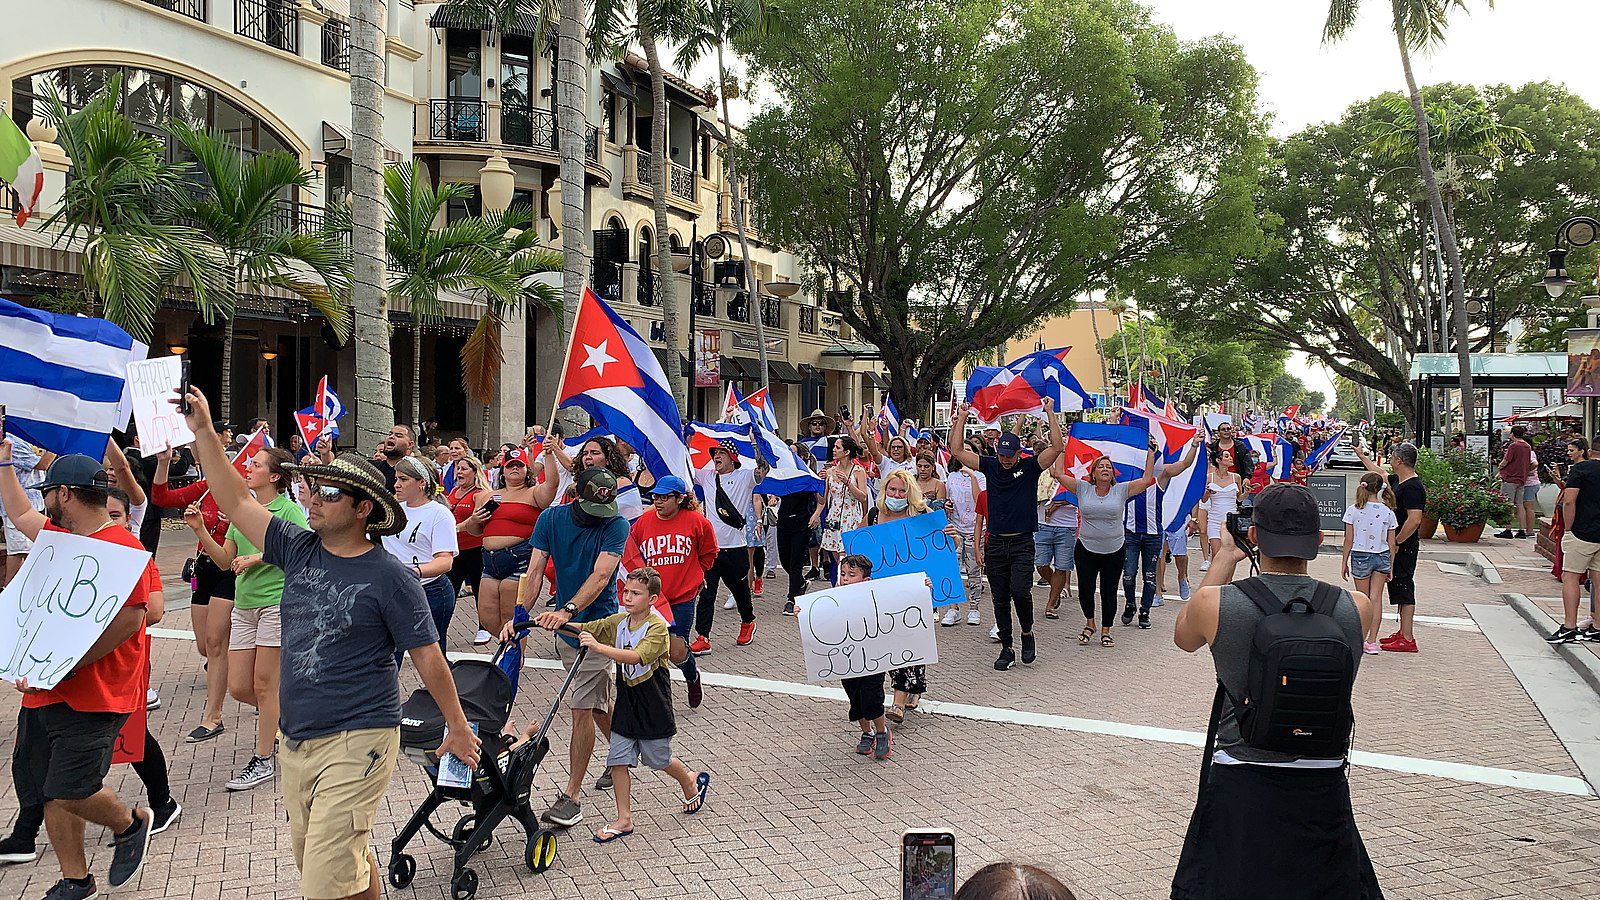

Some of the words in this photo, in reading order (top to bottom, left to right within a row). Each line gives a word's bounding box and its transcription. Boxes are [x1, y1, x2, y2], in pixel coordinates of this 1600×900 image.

[129, 360, 173, 398] PATRIA
[141, 412, 180, 449] VIDA
[639, 534, 692, 560] NAPLES
[646, 555, 685, 567] FLORIDA
[850, 524, 952, 573] Cuba
[19, 545, 119, 630] CuBa
[808, 590, 928, 646] Cuba
[0, 610, 74, 685] Libre
[811, 645, 925, 678] Libre
